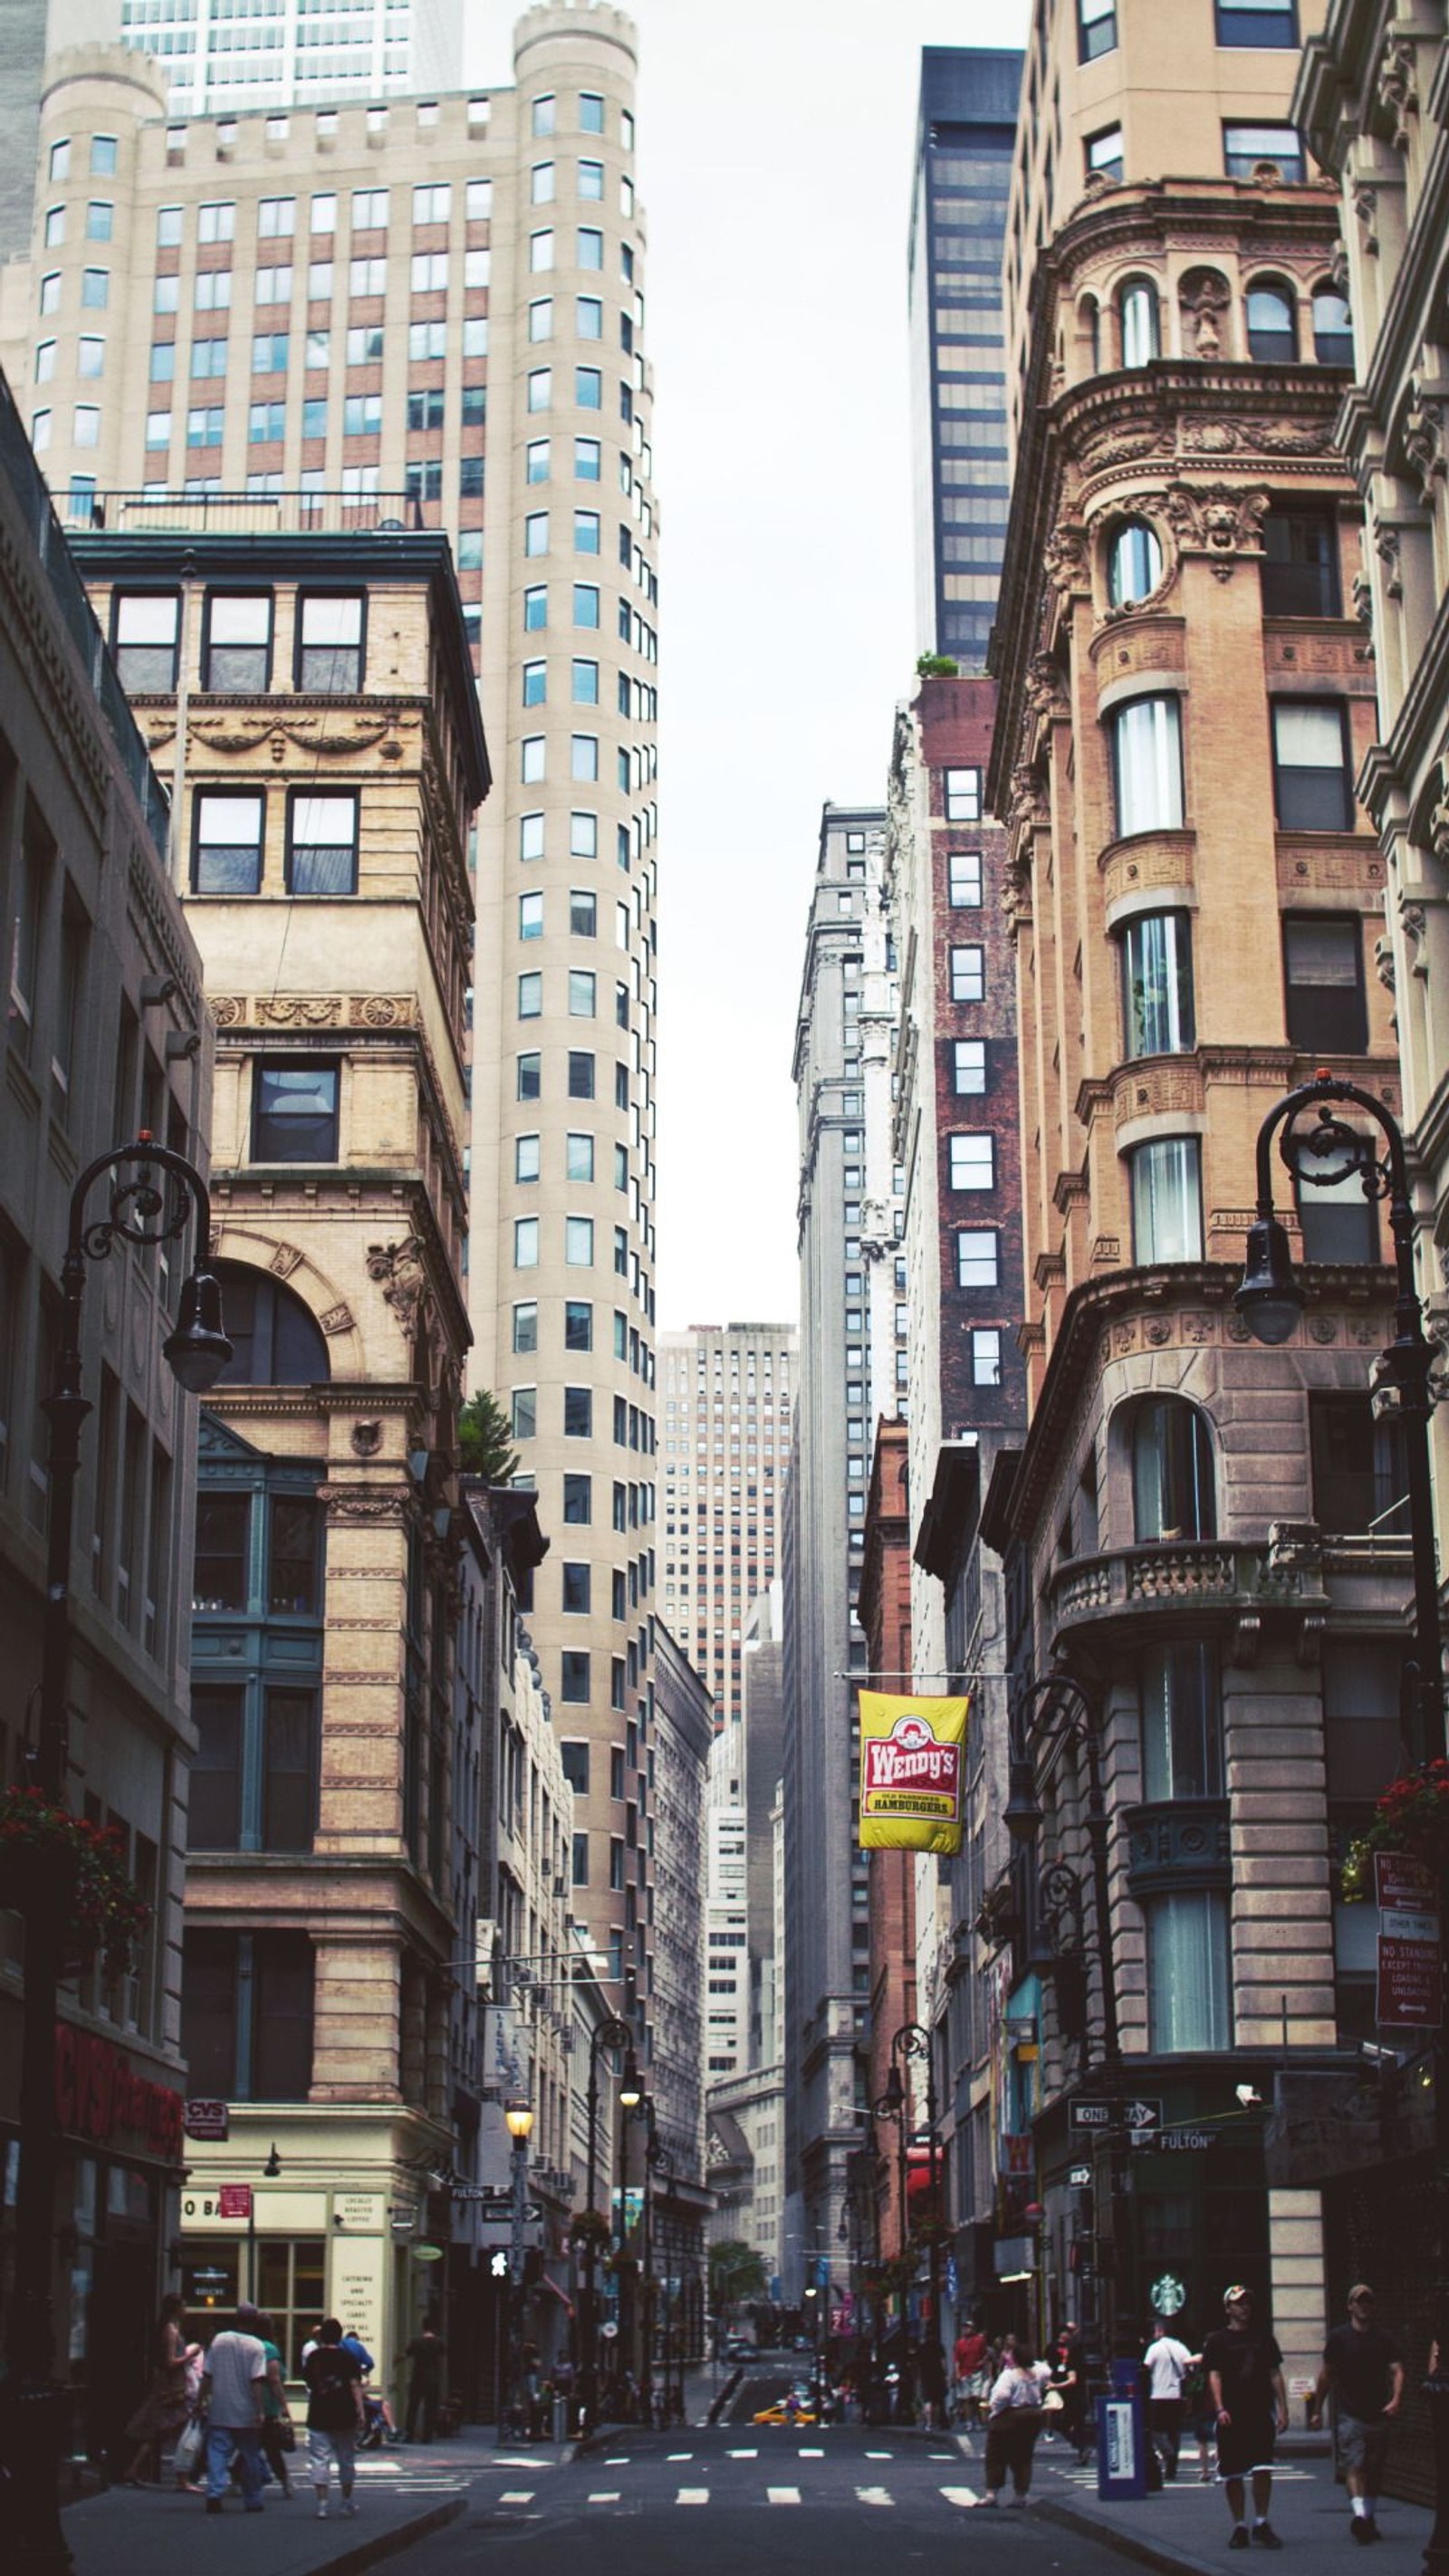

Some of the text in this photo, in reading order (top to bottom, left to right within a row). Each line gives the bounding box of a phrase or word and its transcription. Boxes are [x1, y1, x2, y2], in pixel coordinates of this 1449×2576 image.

[874, 1800, 947, 1813] HAMBURGERS
[1383, 1946, 1437, 1960] NO STANDING
[1382, 1960, 1410, 1970] EXCEPT
[188, 2102, 223, 2116] CVS
[1082, 2108, 1108, 2121] ONE
[1161, 2136, 1207, 2149] FULTON
[452, 2187, 484, 2198] FULTON
